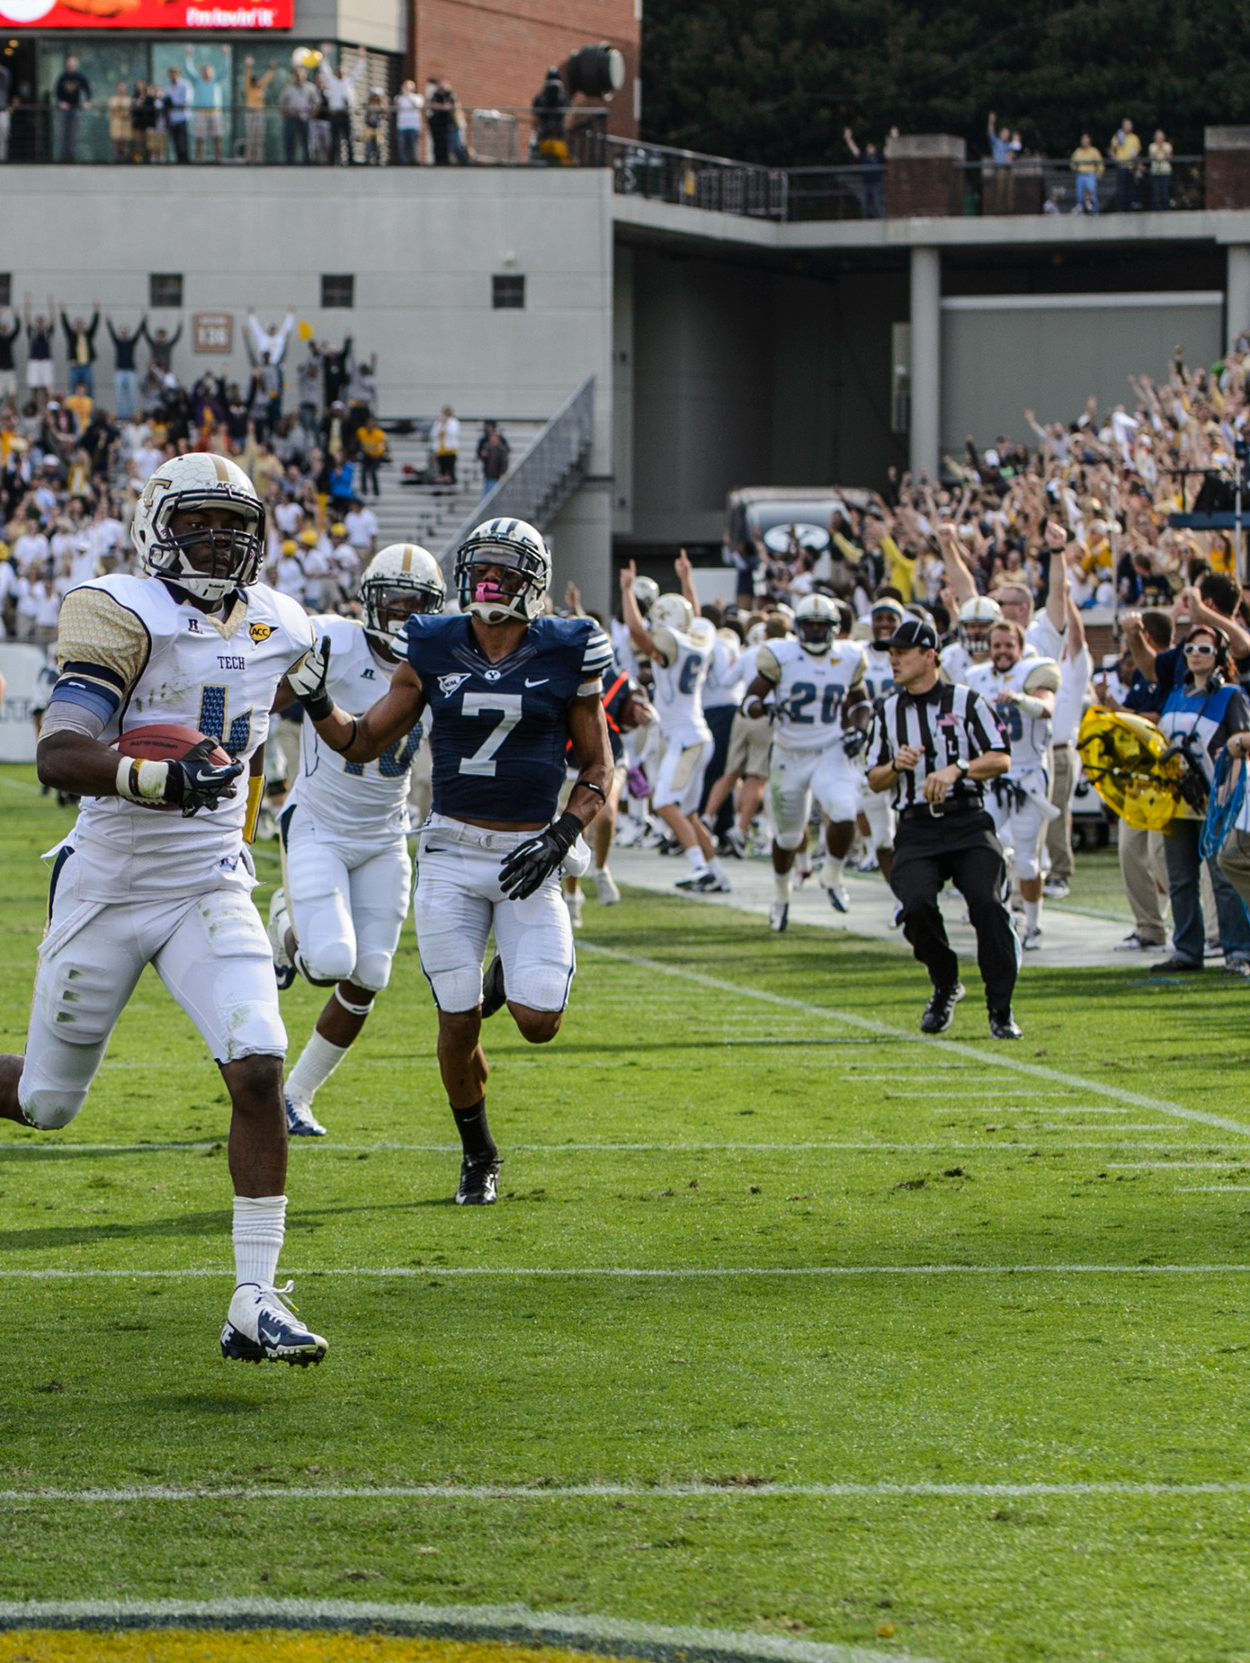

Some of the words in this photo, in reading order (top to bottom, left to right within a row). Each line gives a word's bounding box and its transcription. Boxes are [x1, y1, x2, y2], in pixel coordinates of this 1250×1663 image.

[216, 482, 238, 491] ACC
[250, 627, 269, 637] ACC
[217, 656, 246, 670] TECH
[790, 681, 846, 724] 20
[459, 692, 523, 777] 7
